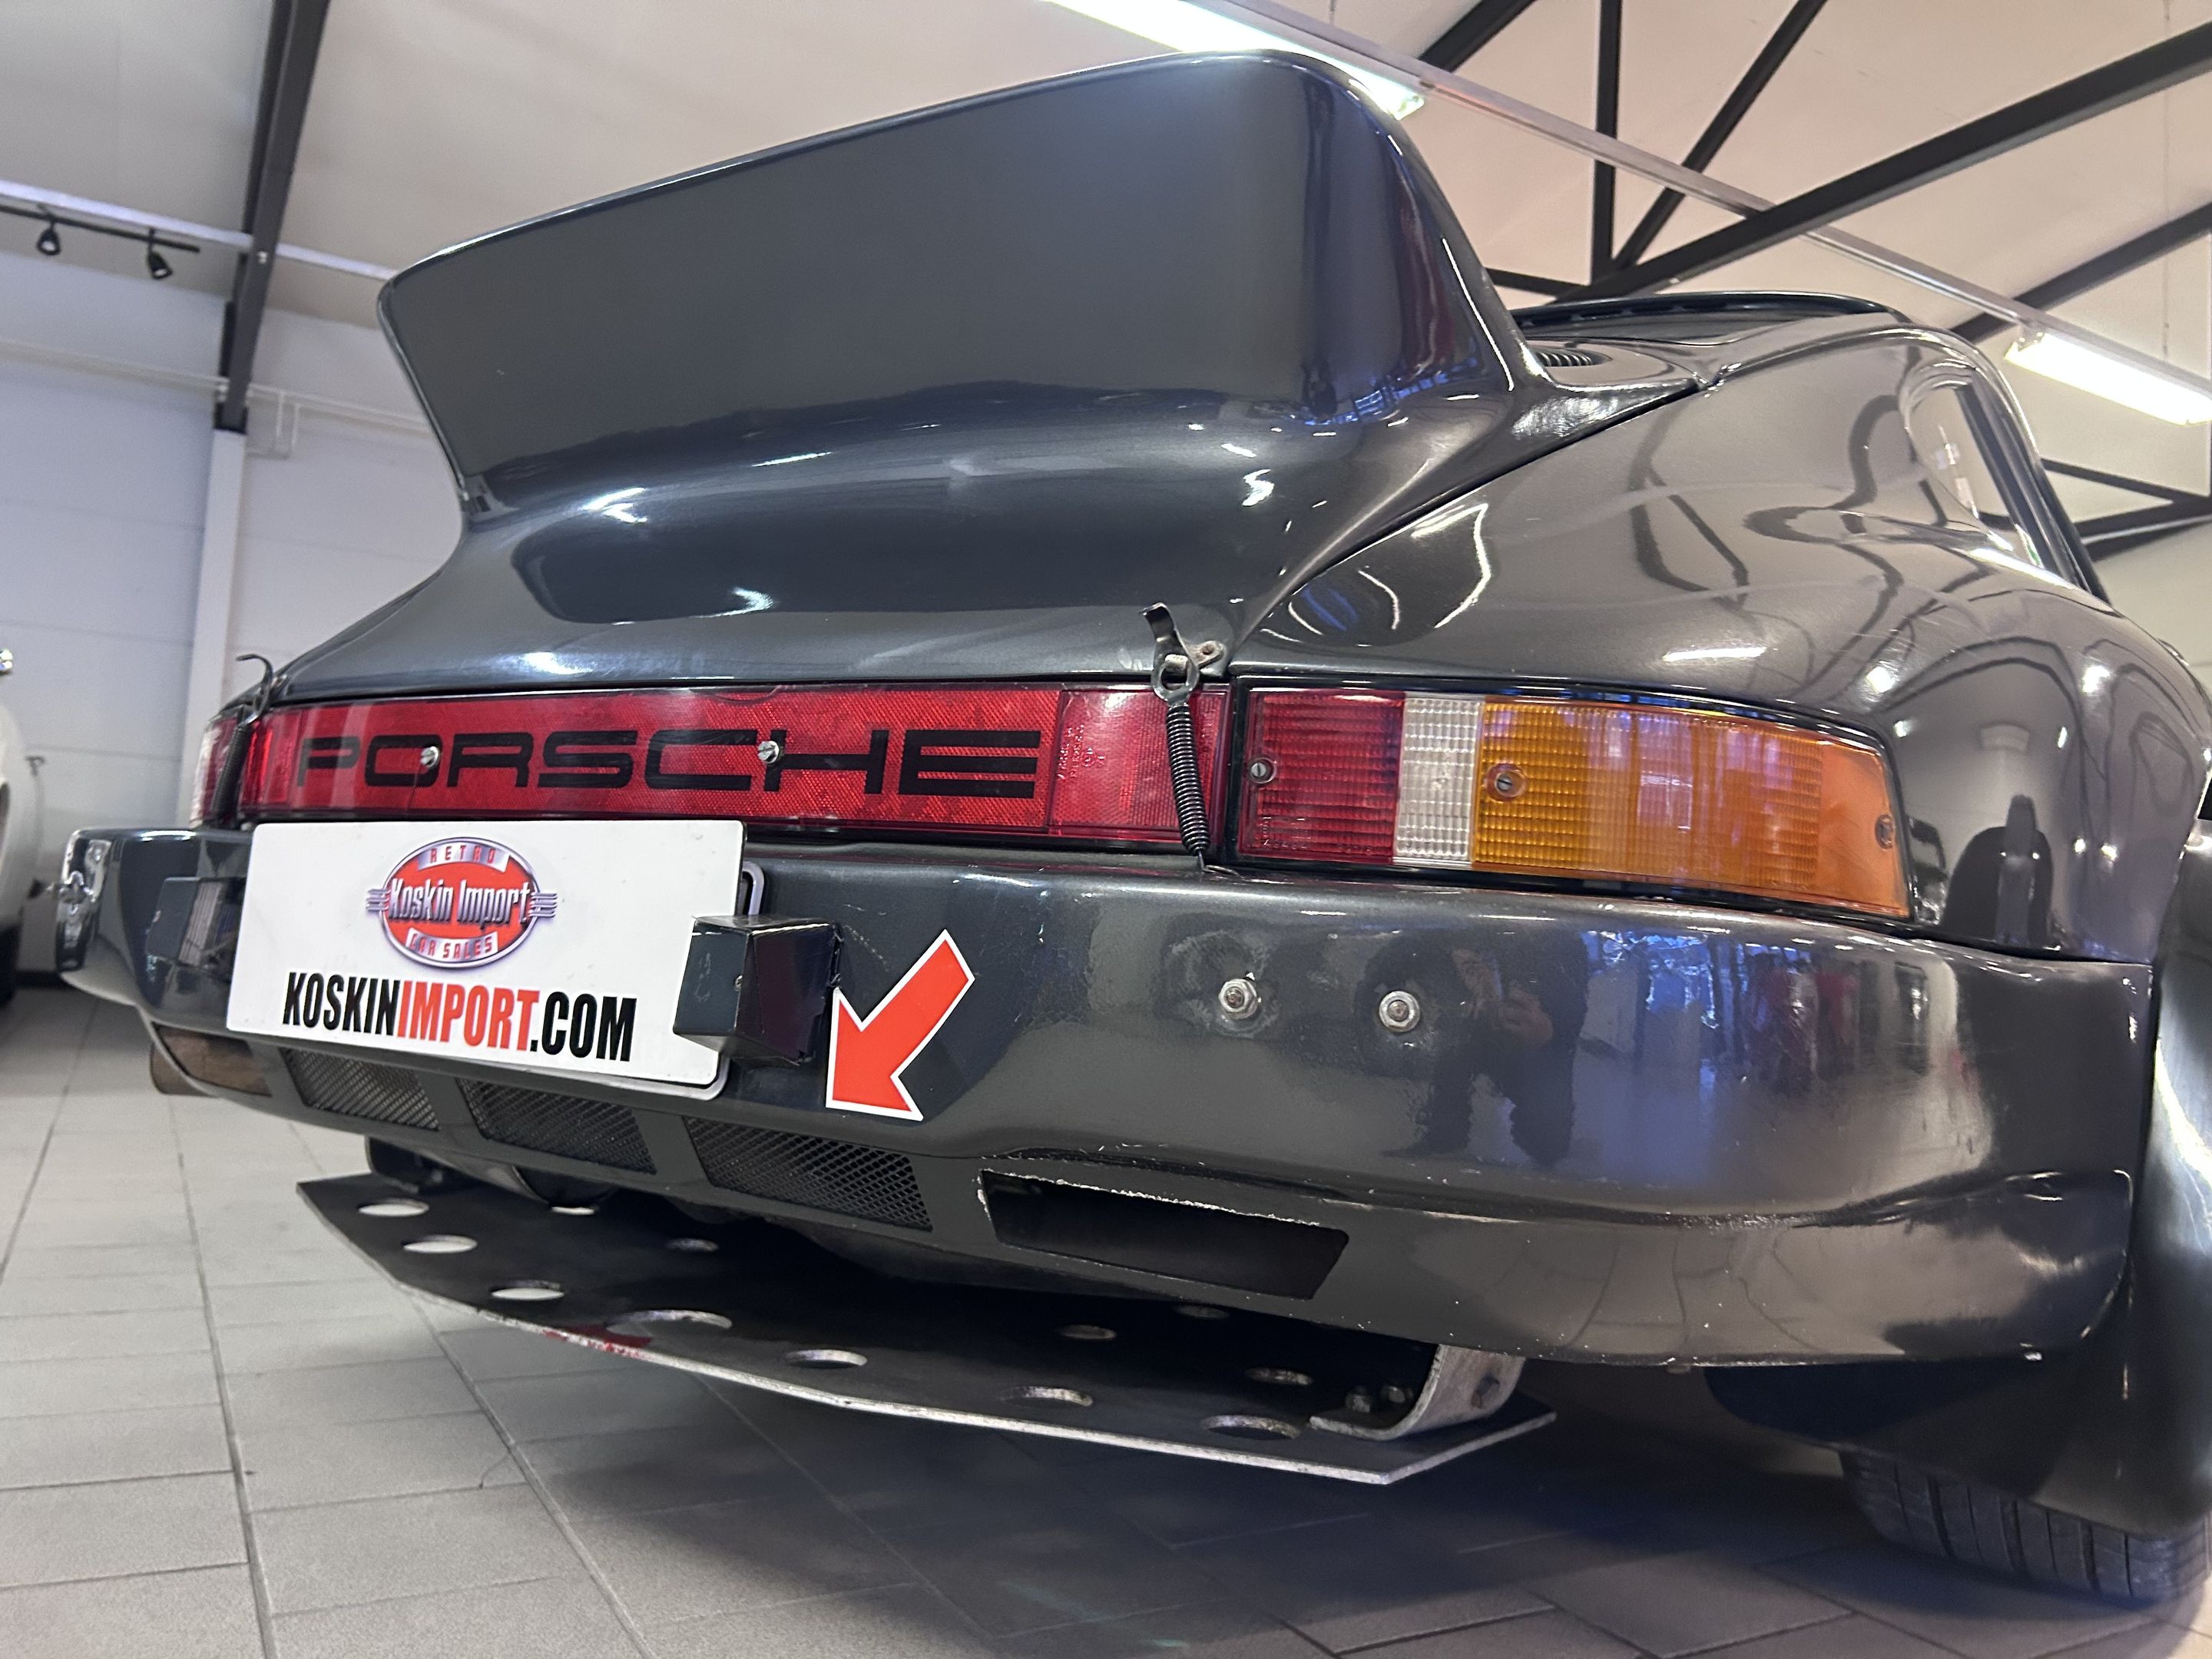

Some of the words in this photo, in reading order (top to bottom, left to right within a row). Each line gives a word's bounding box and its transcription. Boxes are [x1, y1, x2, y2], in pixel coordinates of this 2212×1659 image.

[296, 729, 1041, 799] PORSCHE
[430, 846, 496, 863] RETRO
[389, 878, 454, 919] Koskin
[457, 879, 530, 930] Import
[410, 933, 435, 956] CAR
[443, 936, 492, 959] SALES
[283, 972, 637, 1062] KOSKINIMPORT.COM
